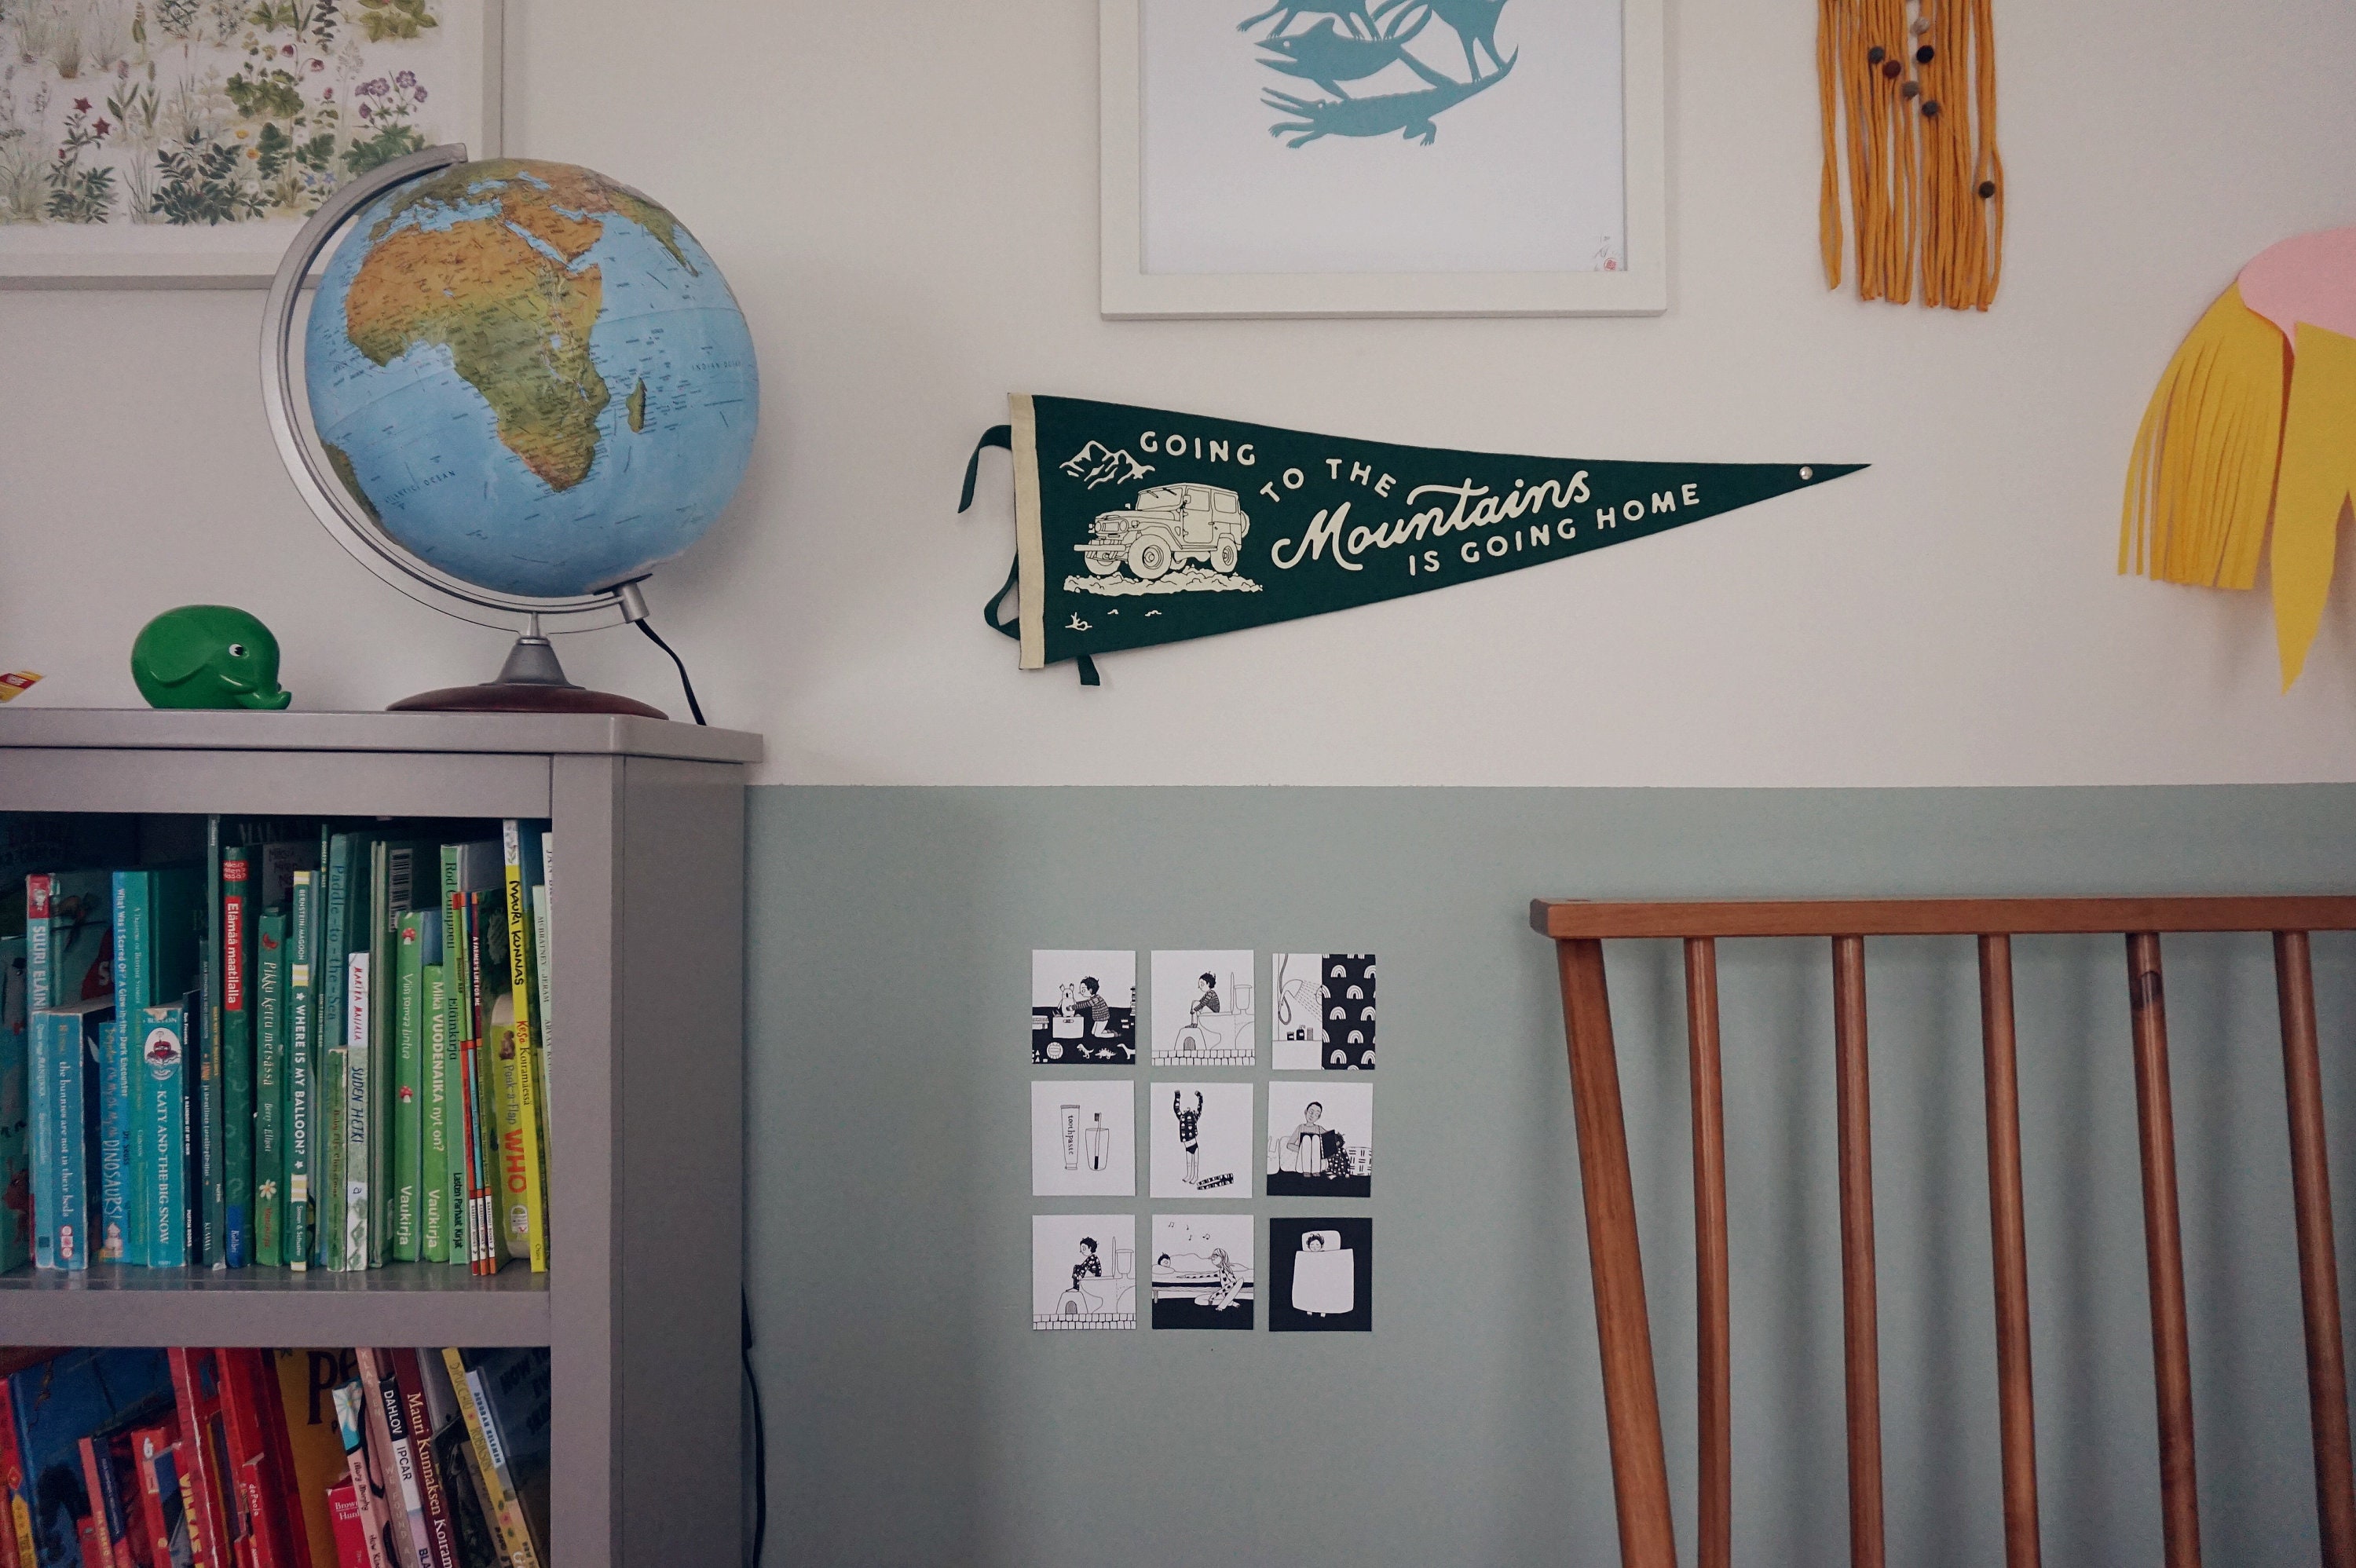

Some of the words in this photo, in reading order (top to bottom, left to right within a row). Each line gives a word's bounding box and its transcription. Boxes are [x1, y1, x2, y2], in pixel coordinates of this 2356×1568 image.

[1139, 430, 1257, 466] GOING
[1259, 468, 1304, 503] TO
[1325, 458, 1396, 499] THE
[1271, 470, 1590, 571] Mountains
[1409, 550, 1441, 577] IS
[1461, 518, 1576, 564] GOING
[1596, 483, 1700, 530] HOME
[445, 862, 458, 886] Rod
[117, 888, 126, 909] What
[509, 880, 523, 925] MAURI
[117, 912, 126, 927] Was
[227, 902, 240, 945] Elämää
[33, 925, 46, 964] SUURI
[118, 935, 127, 961] Scared
[513, 930, 525, 985] KUNNAS
[227, 947, 240, 1004] maatilalla
[262, 962, 276, 993] Pikku
[402, 974, 415, 995] Viisi
[541, 974, 551, 1003] JERAM
[261, 997, 276, 1028] kettu
[474, 996, 480, 1006] ME
[294, 1005, 305, 1048] WHERE
[447, 997, 459, 1060] Eläinkirja
[59, 1061, 71, 1078] the
[263, 1033, 275, 1086] metsässä
[294, 1052, 305, 1064] IS
[433, 1013, 444, 1102] VUODENAIKA
[120, 1057, 129, 1098] Encounter
[294, 1067, 305, 1087] MY
[351, 1066, 364, 1102] SUDEN
[519, 1047, 532, 1106] Koiramäessä
[59, 1079, 71, 1118] bunnies
[156, 1090, 168, 1124] KATY
[294, 1091, 305, 1155] BALLOON?
[351, 1108, 364, 1143] HETKI
[430, 1106, 444, 1126] nyt
[60, 1137, 70, 1153] not
[157, 1125, 168, 1153] AND
[433, 1130, 444, 1152] on?
[1065, 1114, 1076, 1156] toothpaste
[61, 1156, 69, 1165] in
[158, 1155, 169, 1182] THE
[503, 1128, 528, 1193] WHO
[61, 1168, 73, 1193] their
[102, 1139, 123, 1219] DINOSAURS!
[158, 1183, 170, 1204] BIG
[453, 1173, 463, 1197] Lasten
[62, 1194, 74, 1217] beds
[397, 1186, 413, 1245] Vaukirja
[426, 1190, 441, 1248] Vaukirja
[453, 1198, 463, 1226] Parhaat
[159, 1206, 170, 1245] SNOW
[230, 1230, 240, 1253] Kolibri
[453, 1229, 463, 1248] Kirjat
[383, 1389, 402, 1435] DAHLOV
[406, 1391, 430, 1435] Mauri
[354, 1462, 364, 1482] Mary
[397, 1446, 412, 1480] IPCAR
[416, 1436, 442, 1515] Kunnaksen
[179, 1472, 203, 1553] VILKAS
[358, 1484, 370, 1511] Murphy
[368, 1534, 378, 1550] How
